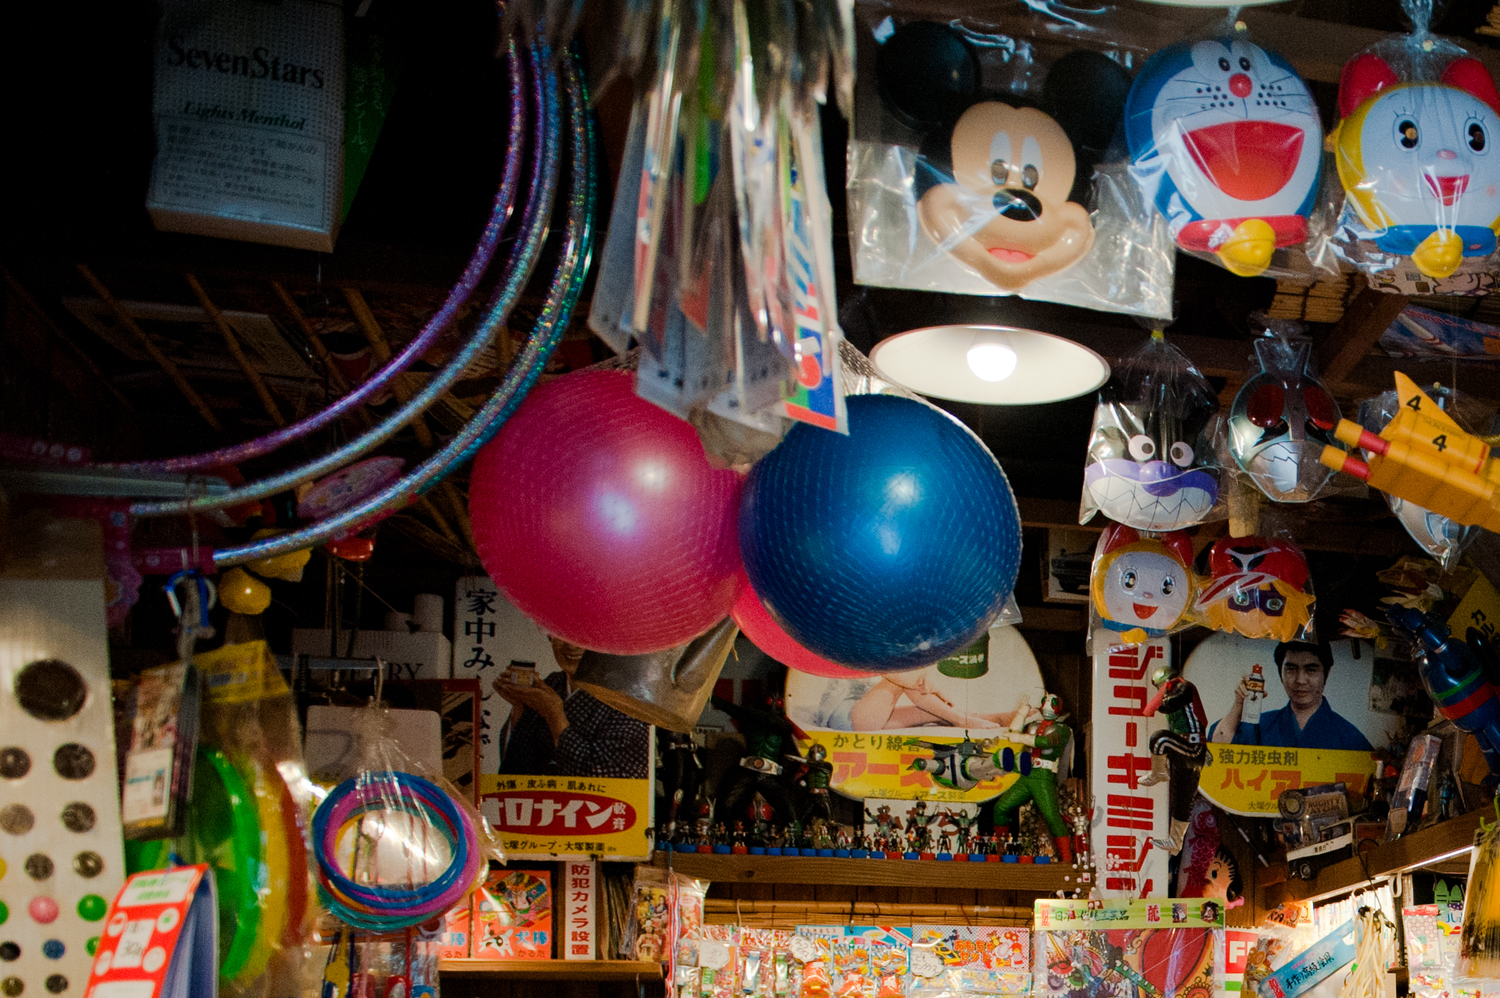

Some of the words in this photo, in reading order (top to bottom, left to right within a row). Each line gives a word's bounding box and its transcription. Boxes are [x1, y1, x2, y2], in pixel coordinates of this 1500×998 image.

[167, 34, 324, 89] SevenStars
[183, 101, 234, 120] Lights
[236, 108, 306, 131] Menthol
[1406, 395, 1422, 412] 4
[1432, 434, 1448, 451] 4
[1219, 748, 1298, 766] 強力殺虫剤
[571, 864, 589, 956] 防犯カメラ設置
[953, 939, 995, 952] おもちゃ
[959, 951, 992, 963] セット
